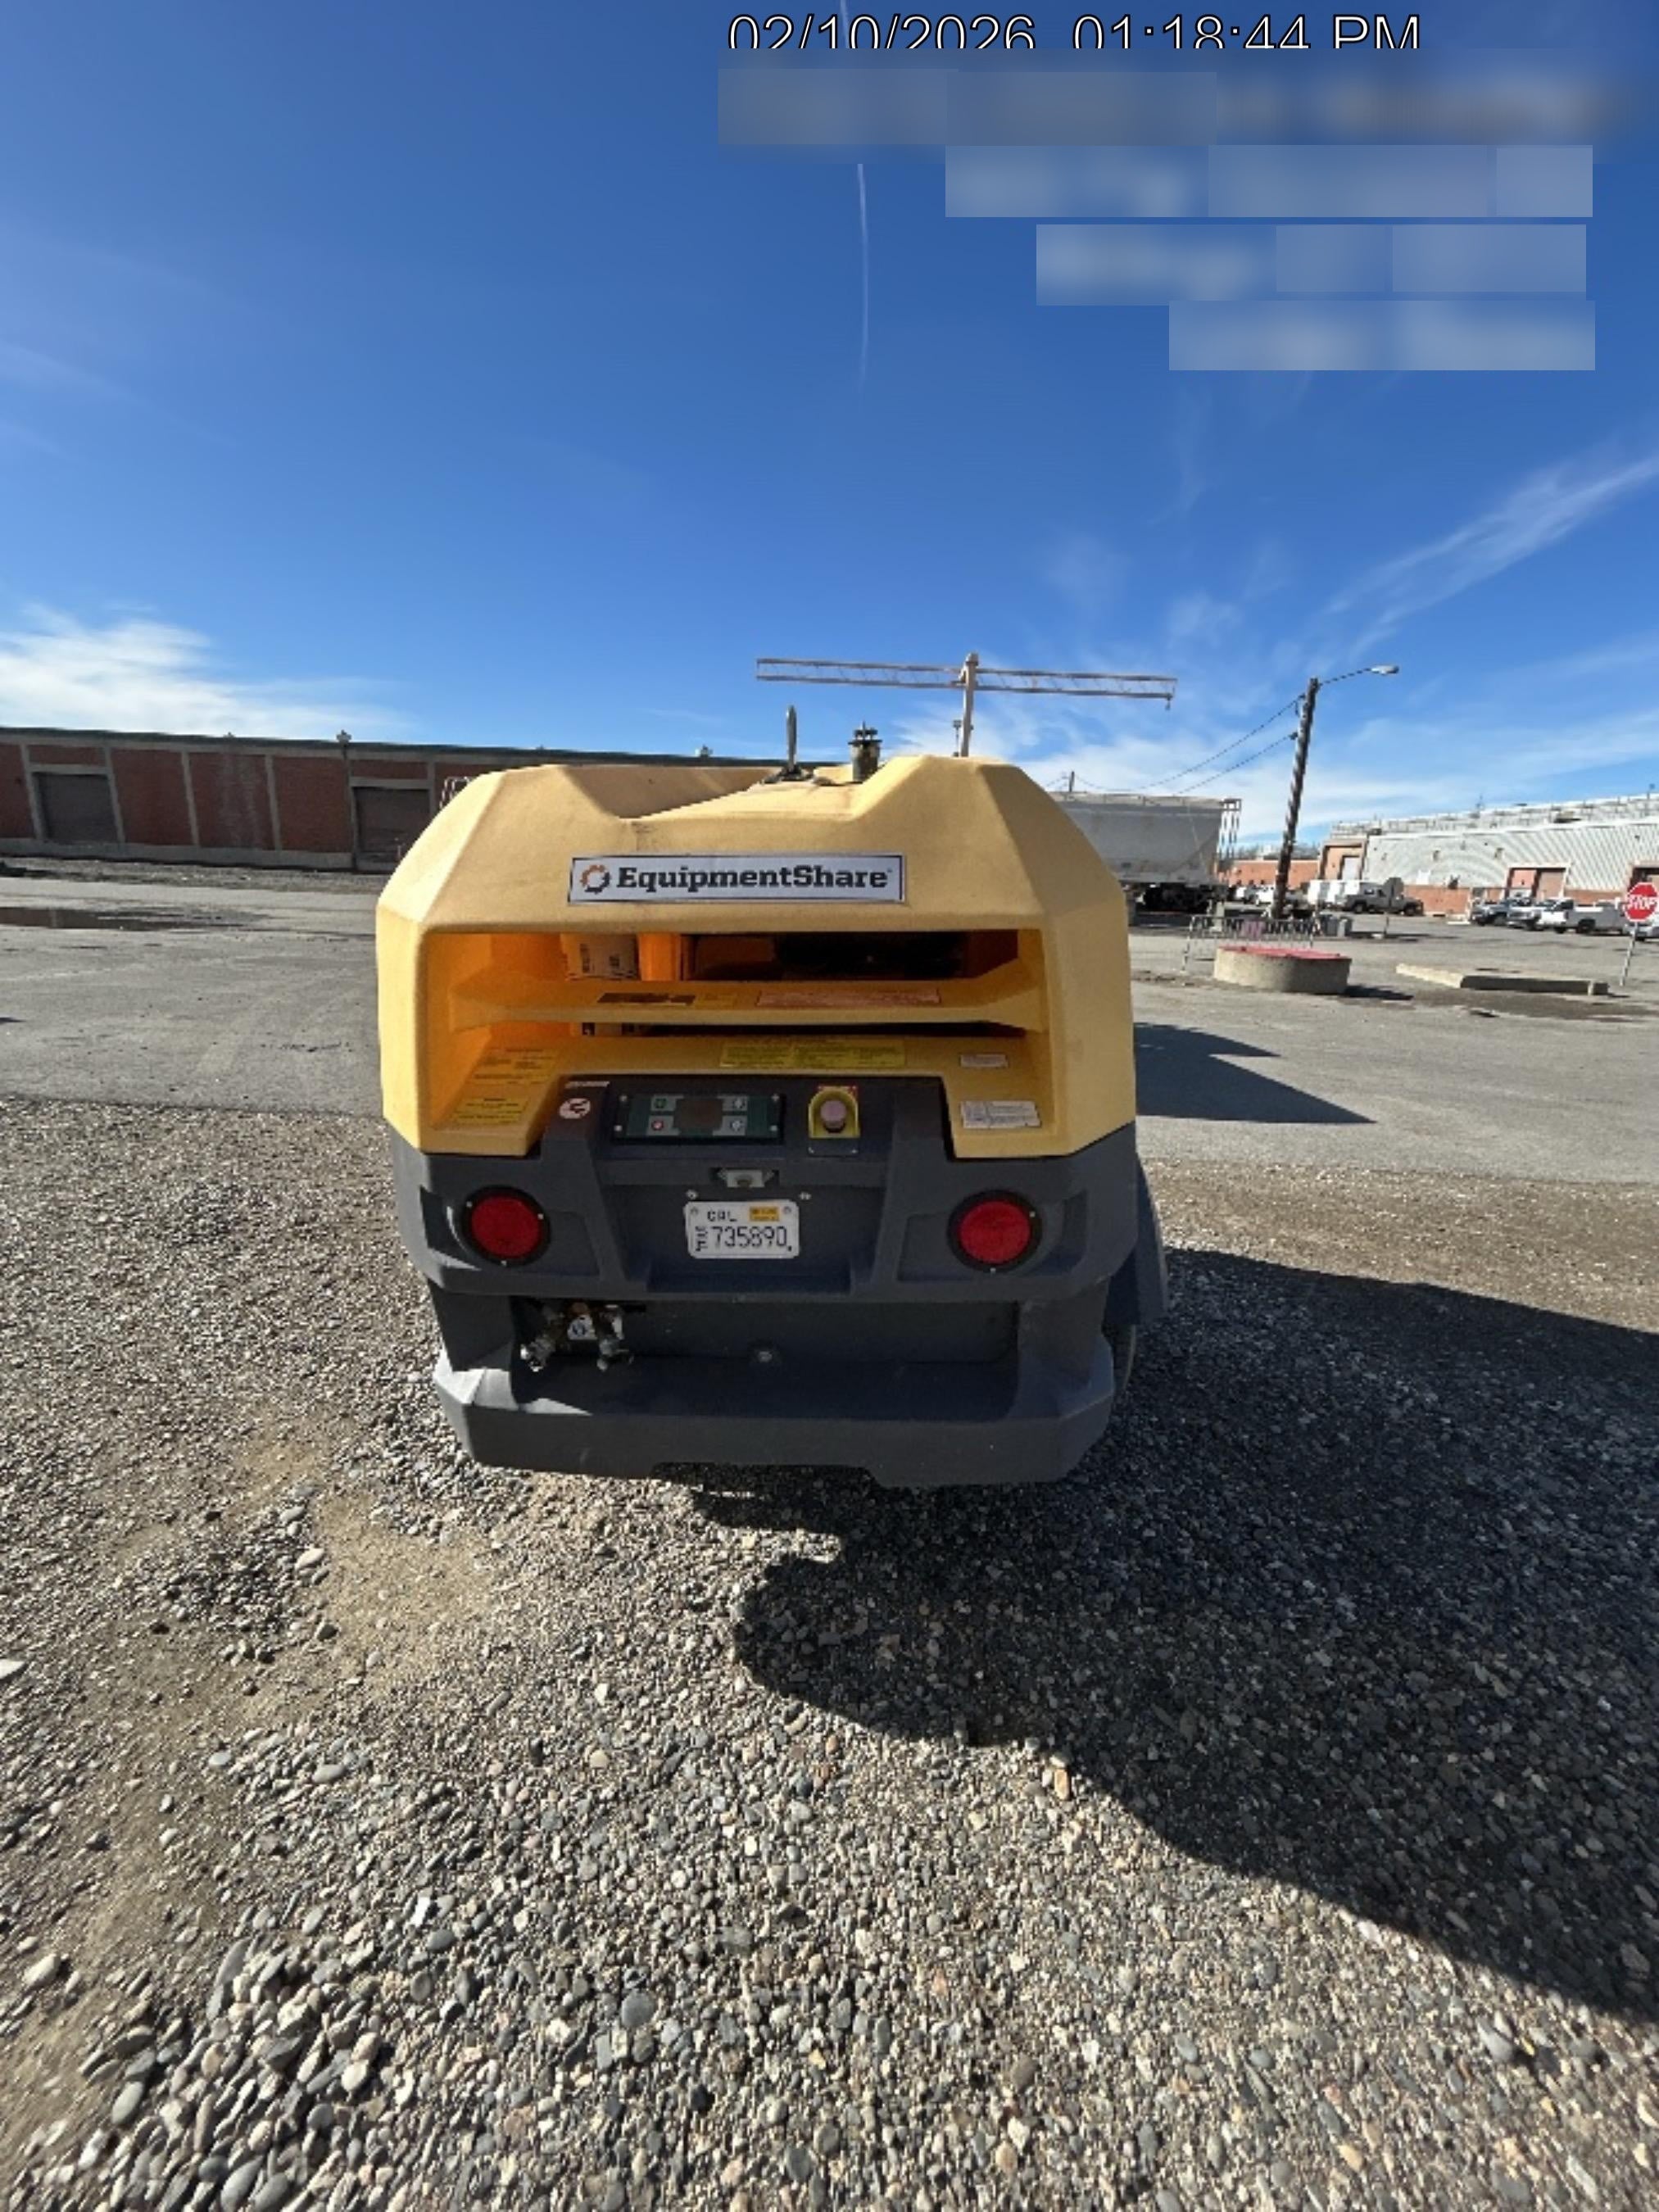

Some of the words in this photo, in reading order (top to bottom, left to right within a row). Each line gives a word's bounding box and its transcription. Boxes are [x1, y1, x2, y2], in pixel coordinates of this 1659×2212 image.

[616, 865, 888, 892] EquipmentShare
[1627, 894, 1658, 910] STOP
[707, 1209, 737, 1222] CAL
